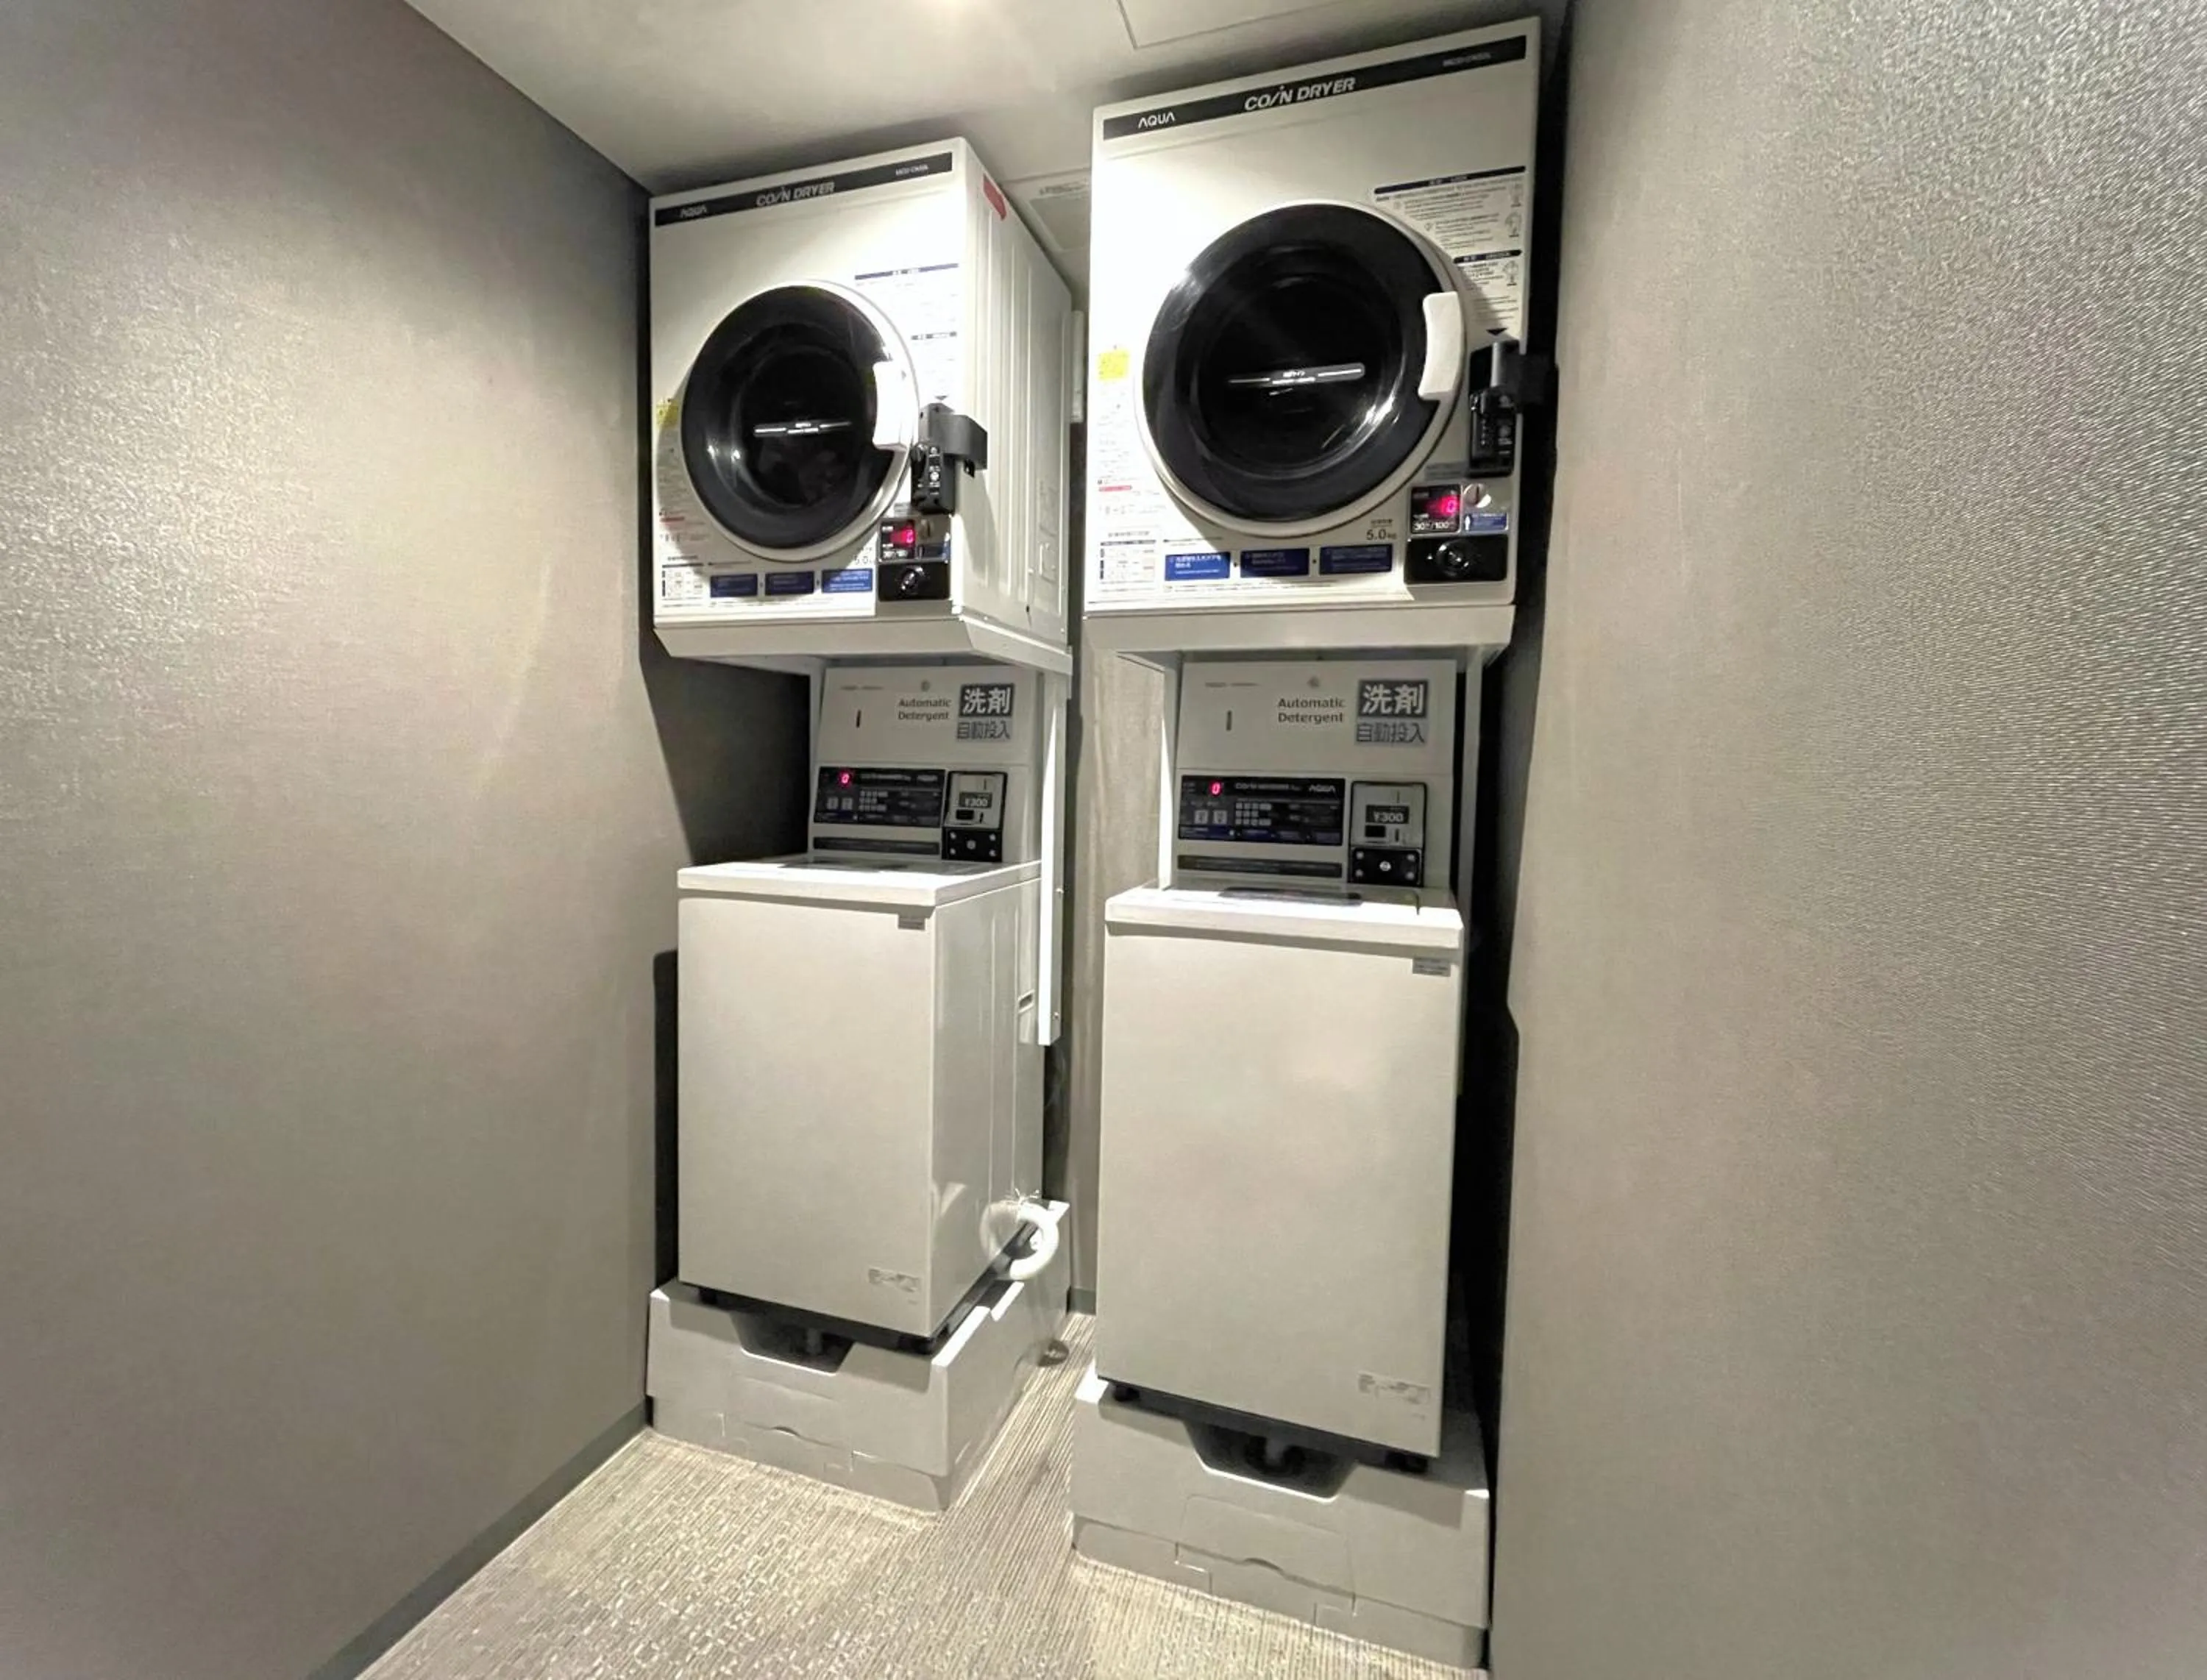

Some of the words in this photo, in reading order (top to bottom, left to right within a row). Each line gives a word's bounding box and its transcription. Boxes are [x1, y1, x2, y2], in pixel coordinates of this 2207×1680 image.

[1297, 76, 1356, 102] DRYER
[1138, 112, 1176, 129] AQUA
[793, 181, 836, 201] DRYER
[898, 698, 951, 708] Automatic
[962, 688, 1011, 714] 洗剤
[1277, 697, 1345, 708] Automatic
[1362, 684, 1424, 714] 洗剤
[898, 711, 950, 722] Detergent
[1278, 712, 1343, 724] Detergent
[1356, 722, 1425, 743] 自動投入
